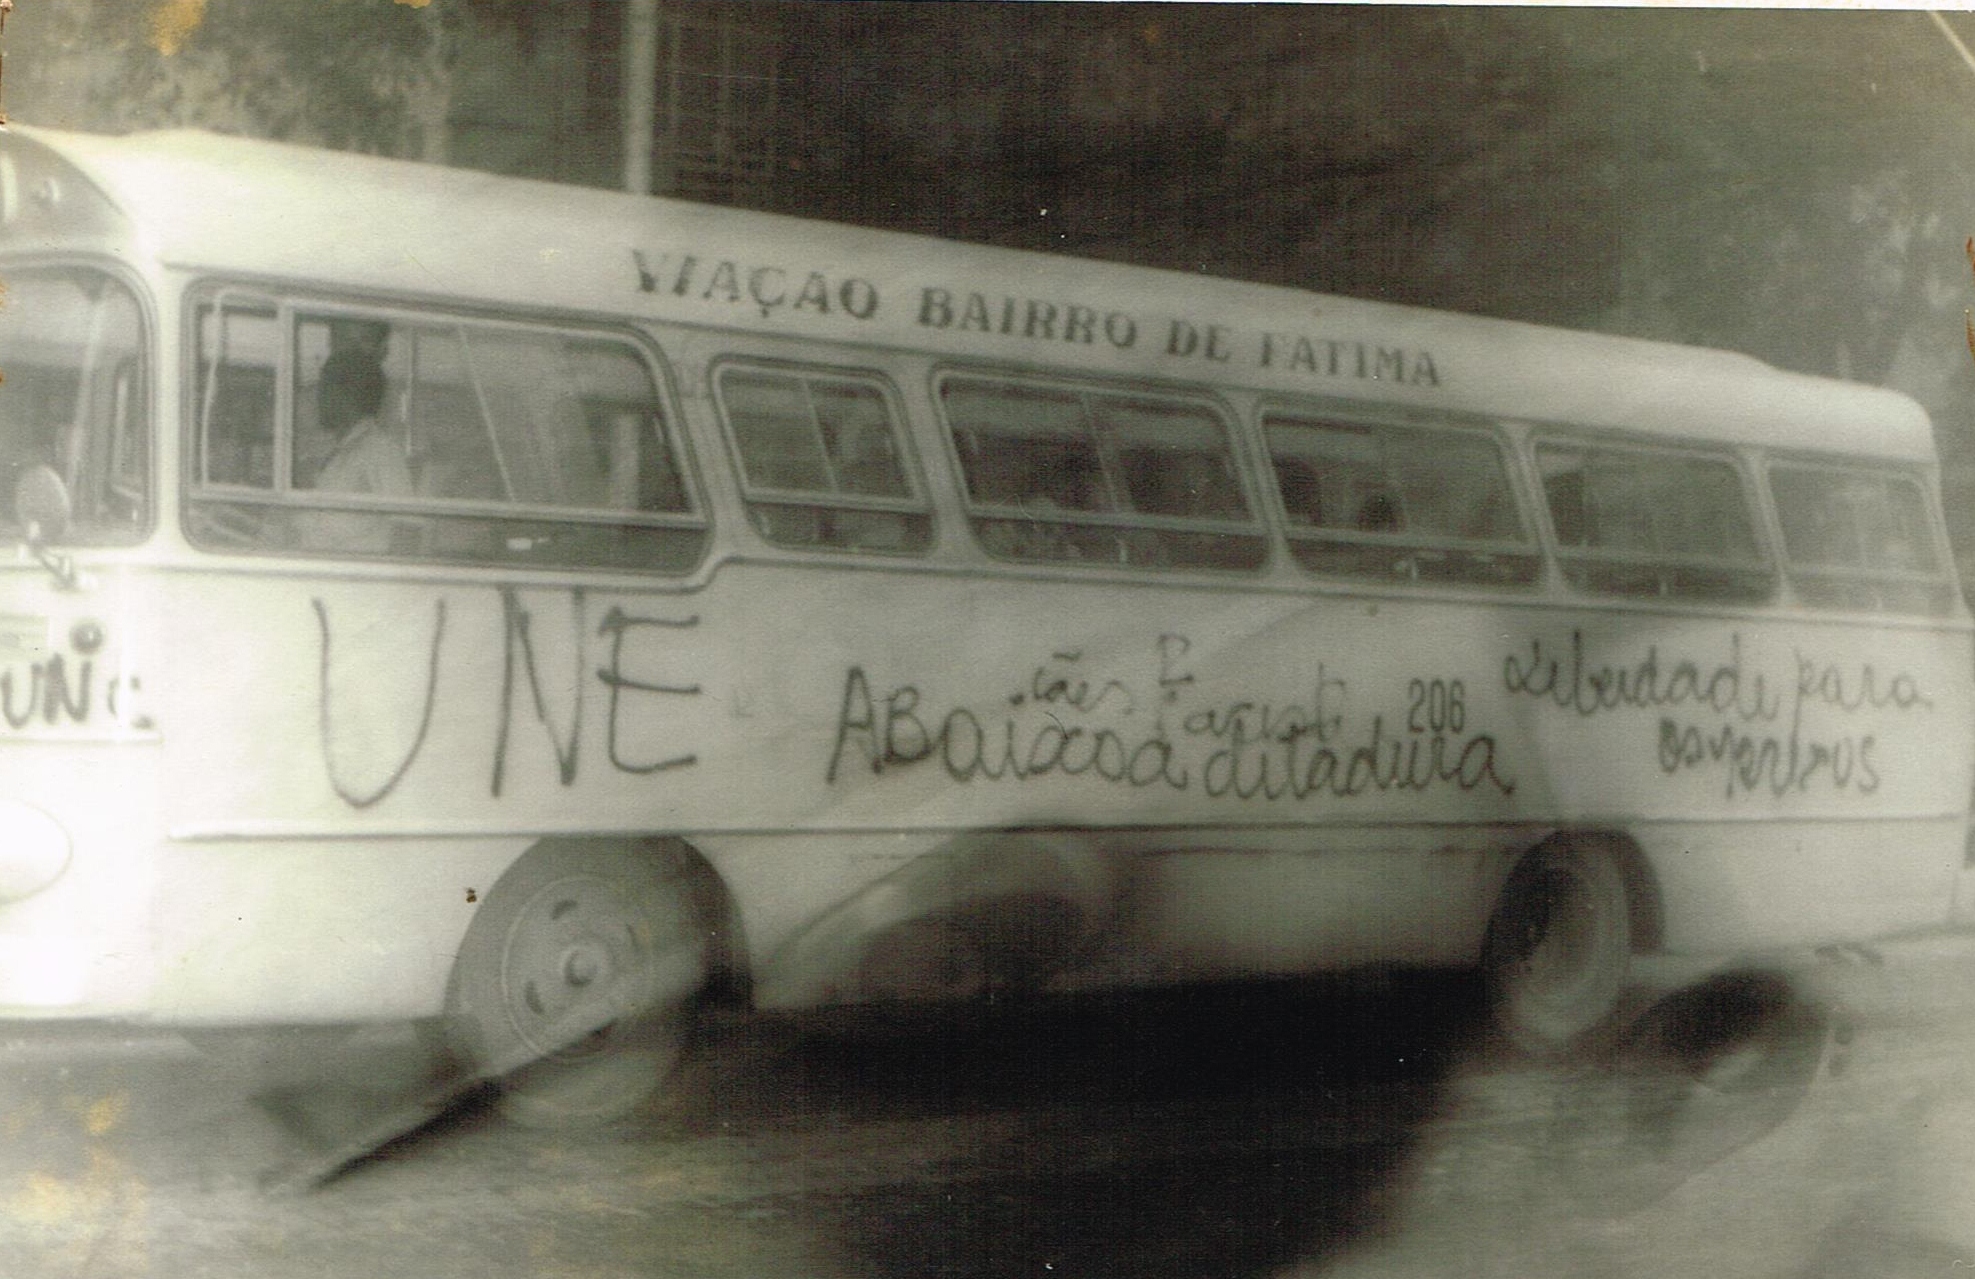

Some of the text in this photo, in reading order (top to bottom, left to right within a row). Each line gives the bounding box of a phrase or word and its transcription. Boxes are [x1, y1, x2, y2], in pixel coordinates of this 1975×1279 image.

[918, 286, 1137, 349] BAIRRO
[1167, 319, 1230, 362] DE
[1259, 332, 1440, 386] FATIMA
[311, 585, 701, 809] UNE
[1409, 677, 1466, 733] 206
